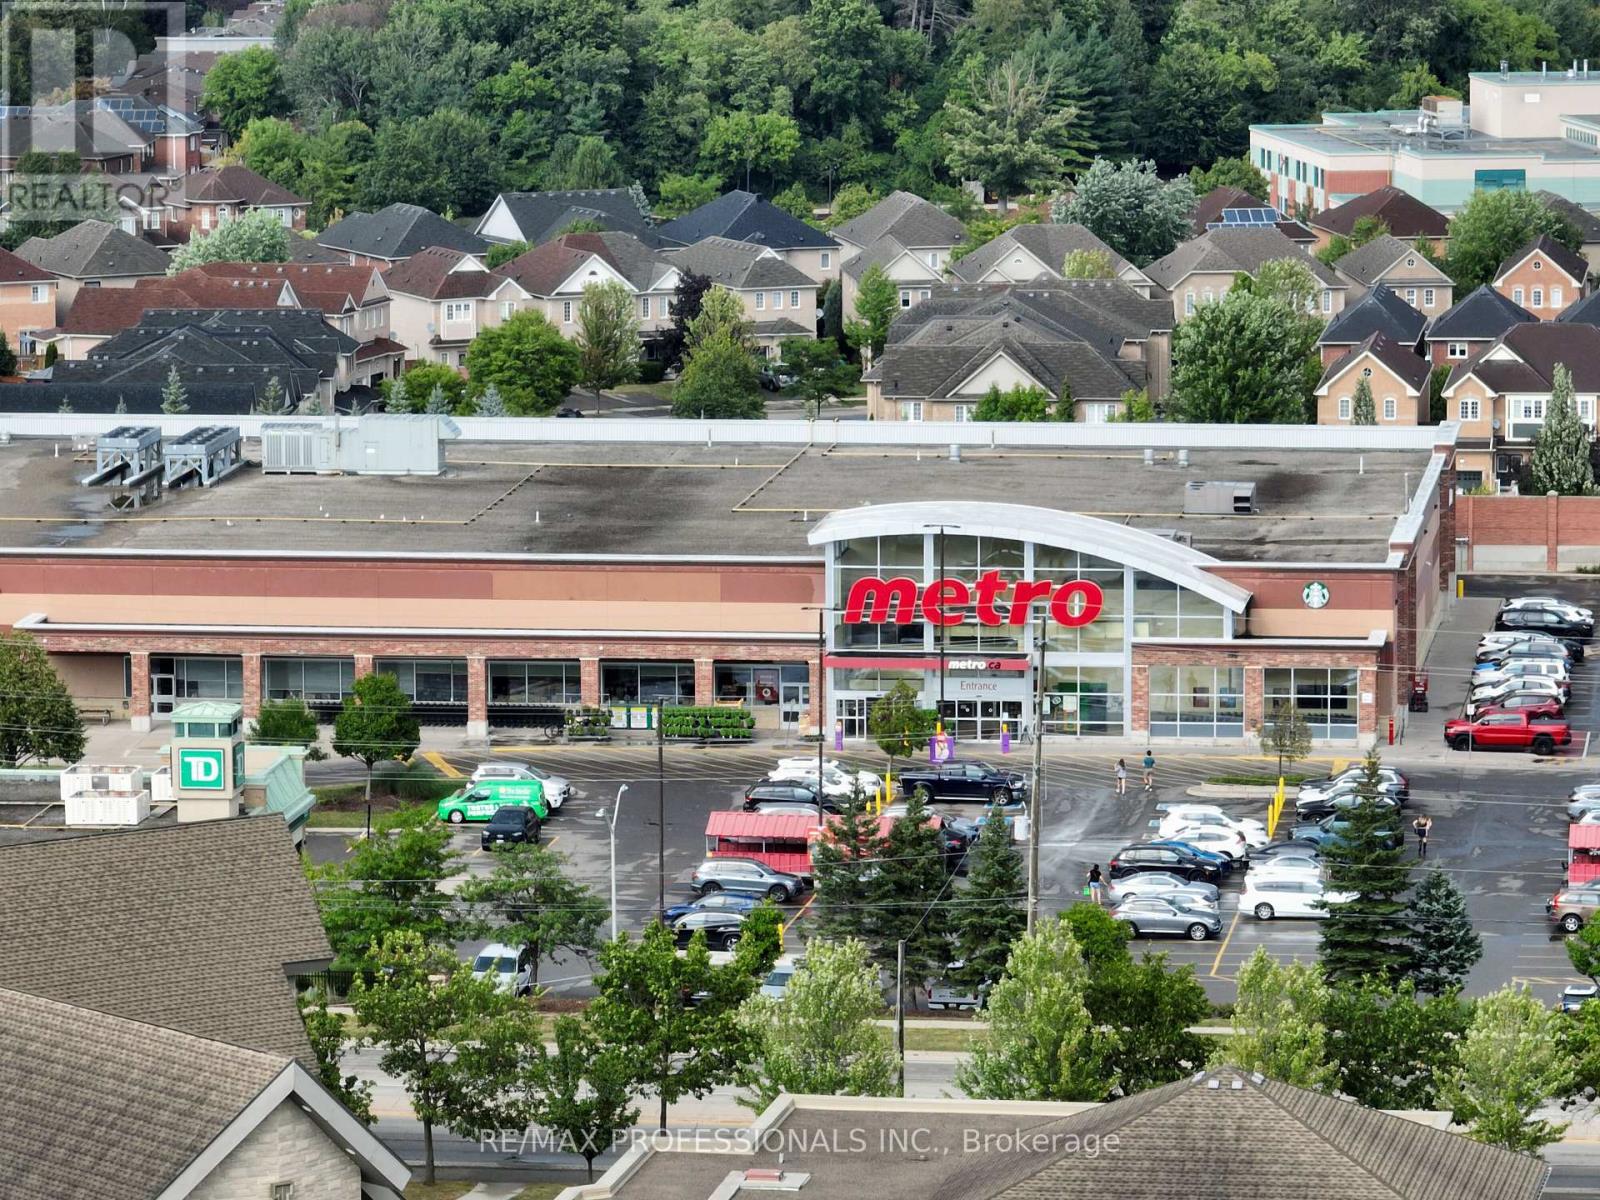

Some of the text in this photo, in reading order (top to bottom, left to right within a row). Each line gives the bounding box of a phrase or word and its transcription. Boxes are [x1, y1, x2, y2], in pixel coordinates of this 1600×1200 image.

[844, 568, 1104, 627] metro
[948, 659, 1002, 670] metro.ca
[960, 680, 998, 691] Entrance
[183, 756, 220, 782] TD
